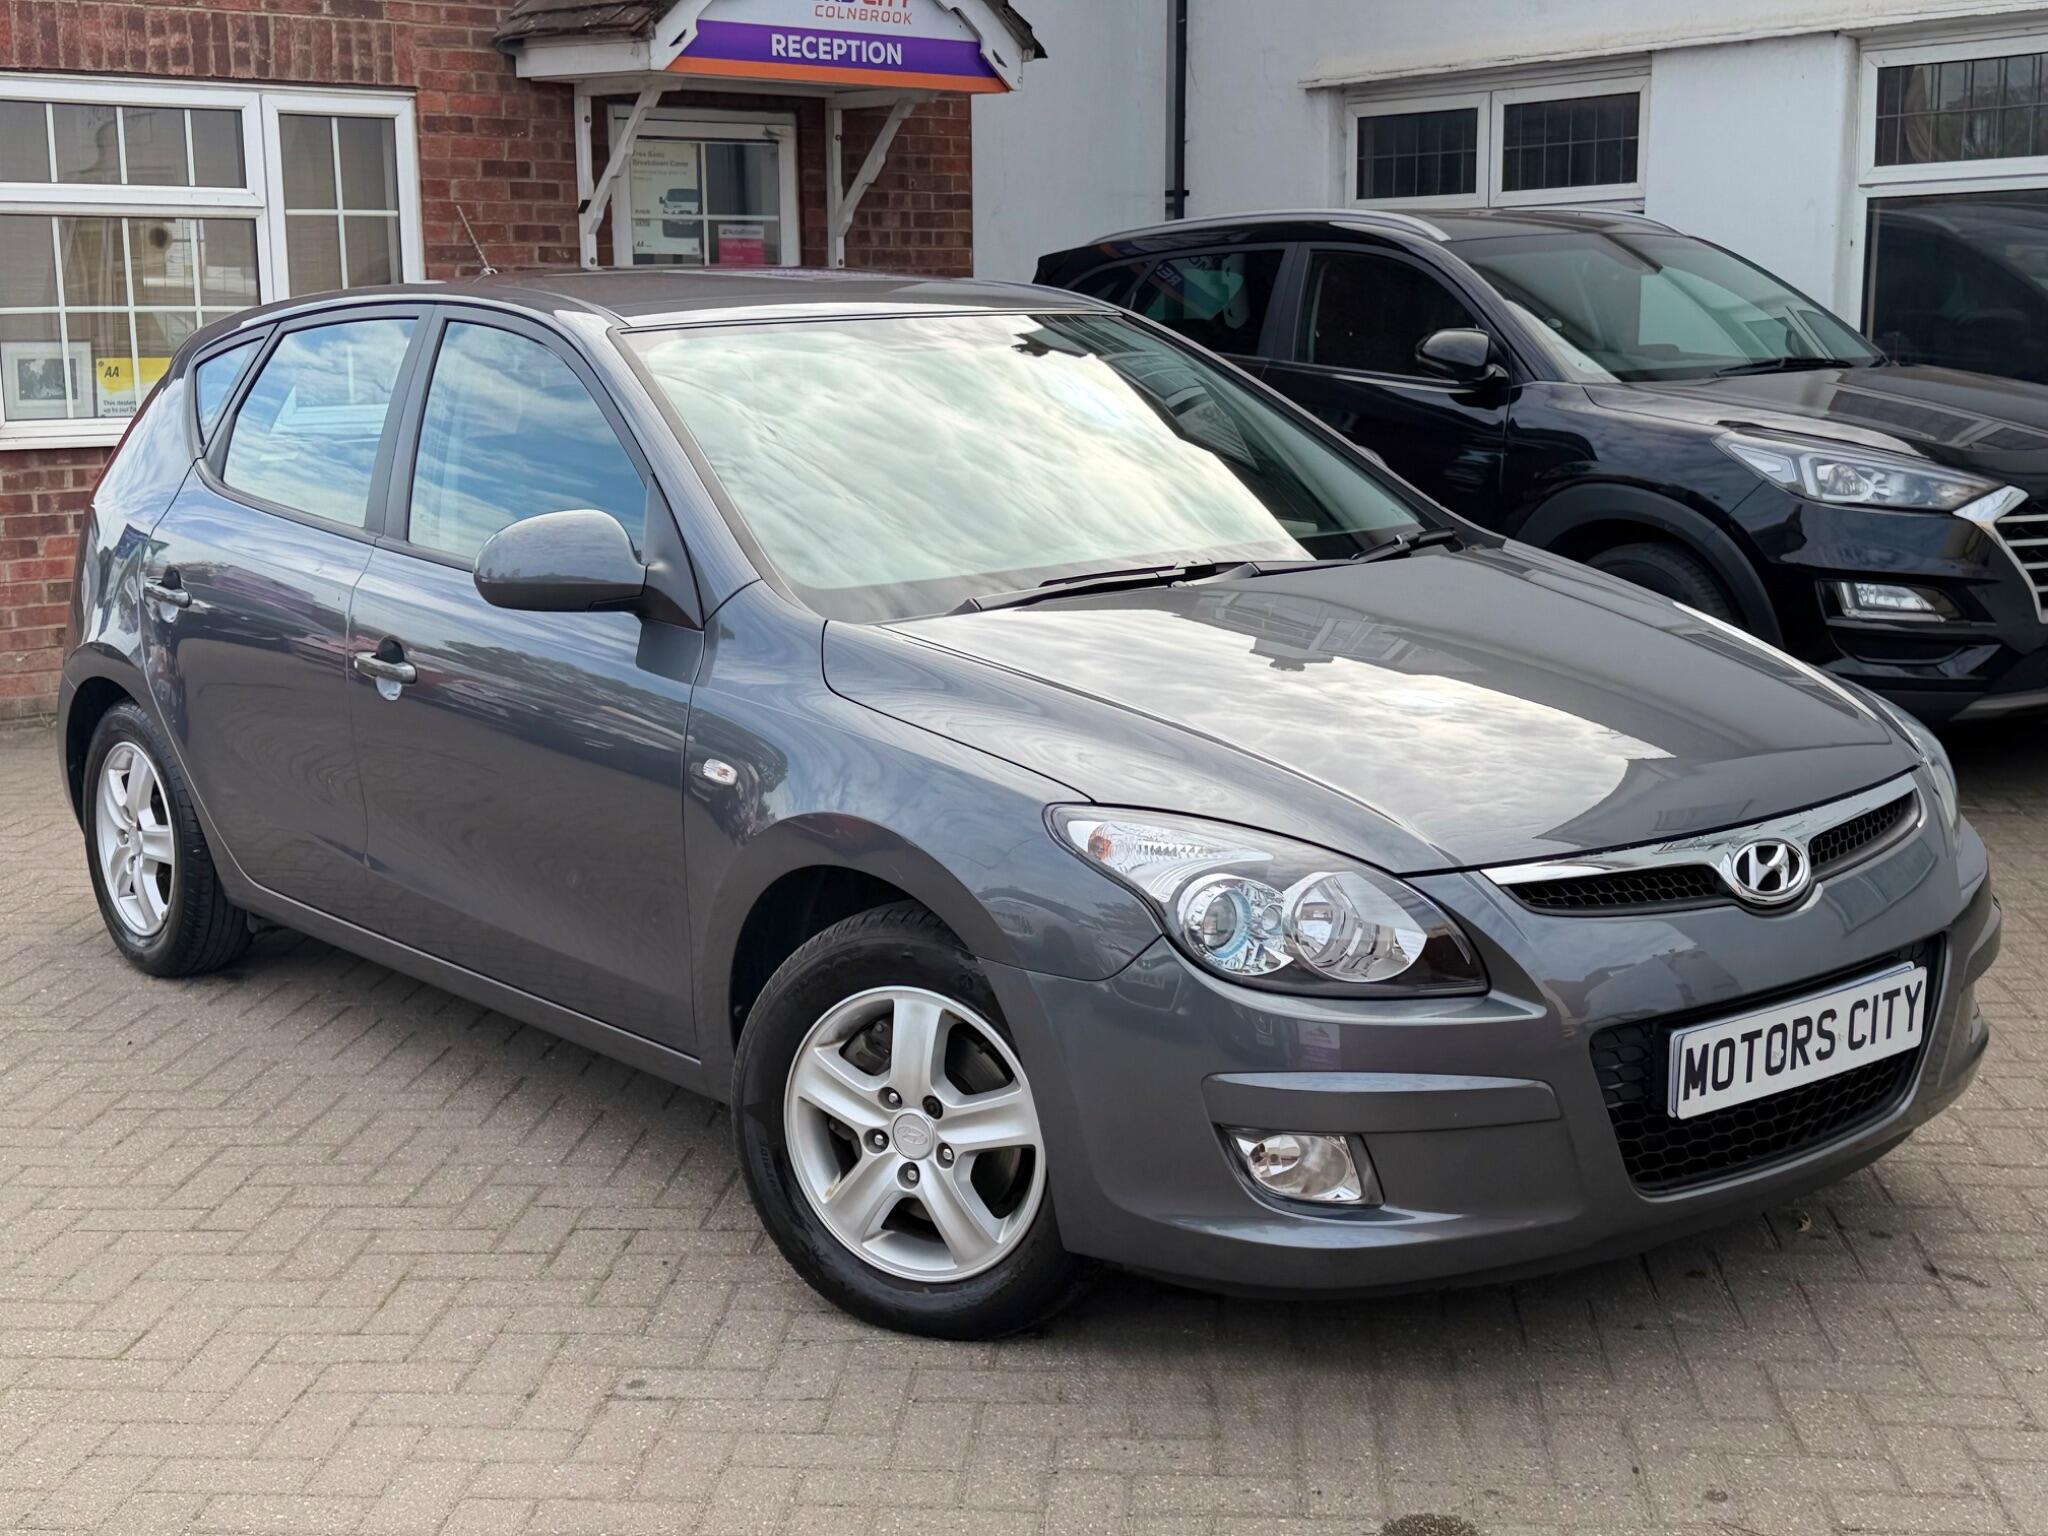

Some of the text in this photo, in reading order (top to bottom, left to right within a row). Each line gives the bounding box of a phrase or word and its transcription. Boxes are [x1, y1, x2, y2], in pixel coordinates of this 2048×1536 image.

[815, 5, 912, 24] COLNBROOK
[771, 33, 902, 65] RECEPTION
[104, 366, 120, 378] AA
[1683, 980, 1923, 1101] MOTORS CITY
